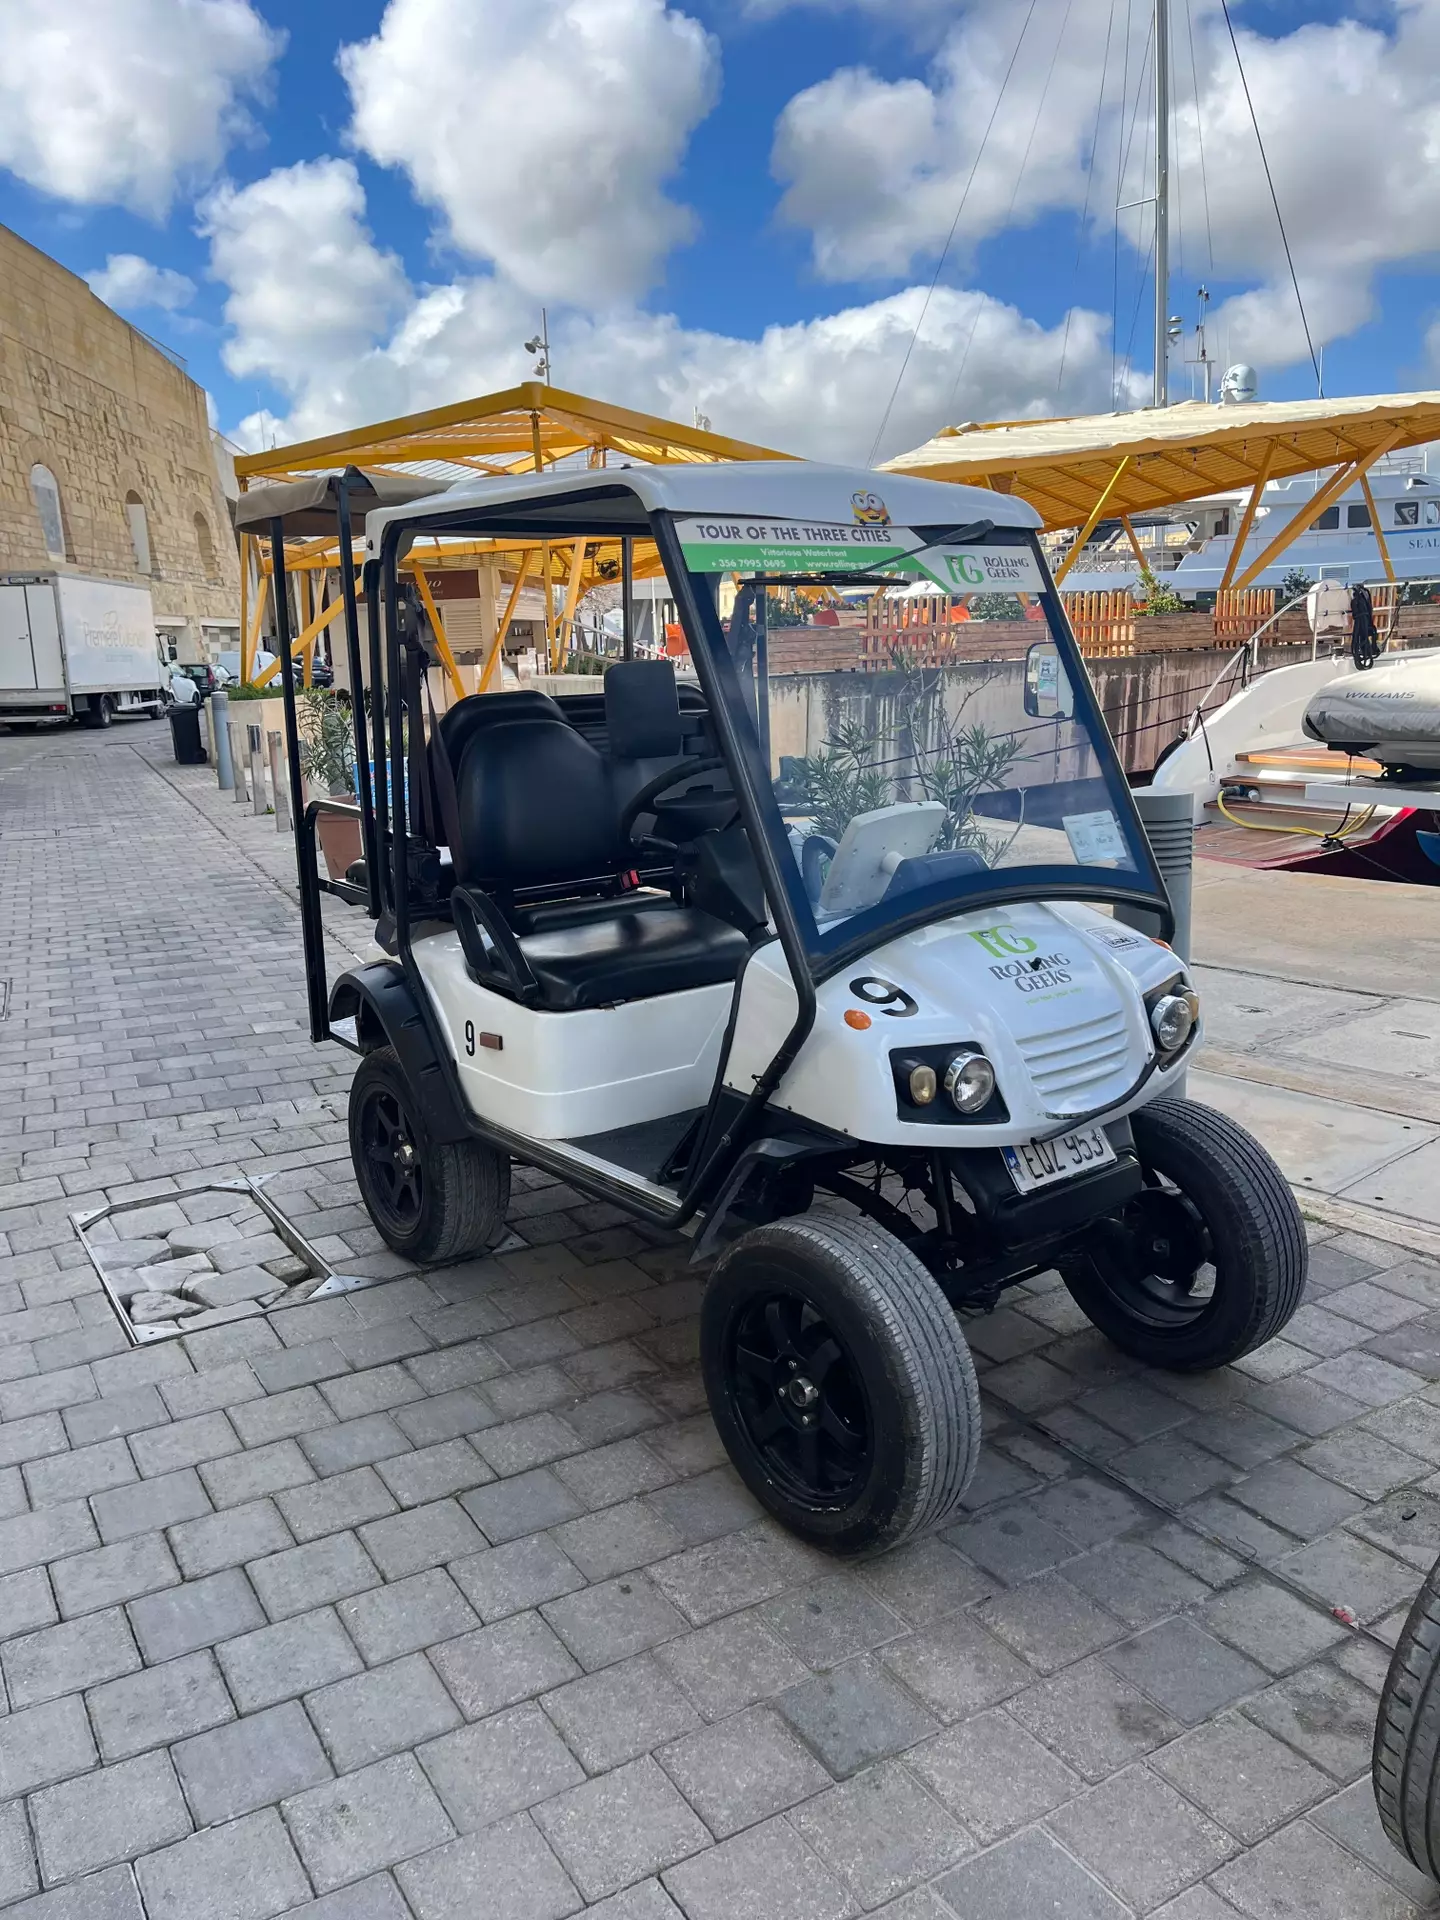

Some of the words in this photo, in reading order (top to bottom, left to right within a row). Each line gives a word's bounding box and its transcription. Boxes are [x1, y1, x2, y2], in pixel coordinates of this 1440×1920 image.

[696, 524, 743, 539] TOUR
[746, 525, 767, 540] OF
[770, 526, 801, 541] THE
[803, 527, 849, 542] THREE
[851, 528, 892, 543] CITIES
[719, 559, 737, 568] 356
[738, 559, 762, 569] 7995
[983, 555, 1029, 568] ROLLING
[1345, 691, 1416, 700] WILLIAMS
[1014, 968, 1072, 993] GEEKS
[849, 976, 919, 1018] 9
[465, 1019, 475, 1057] 9
